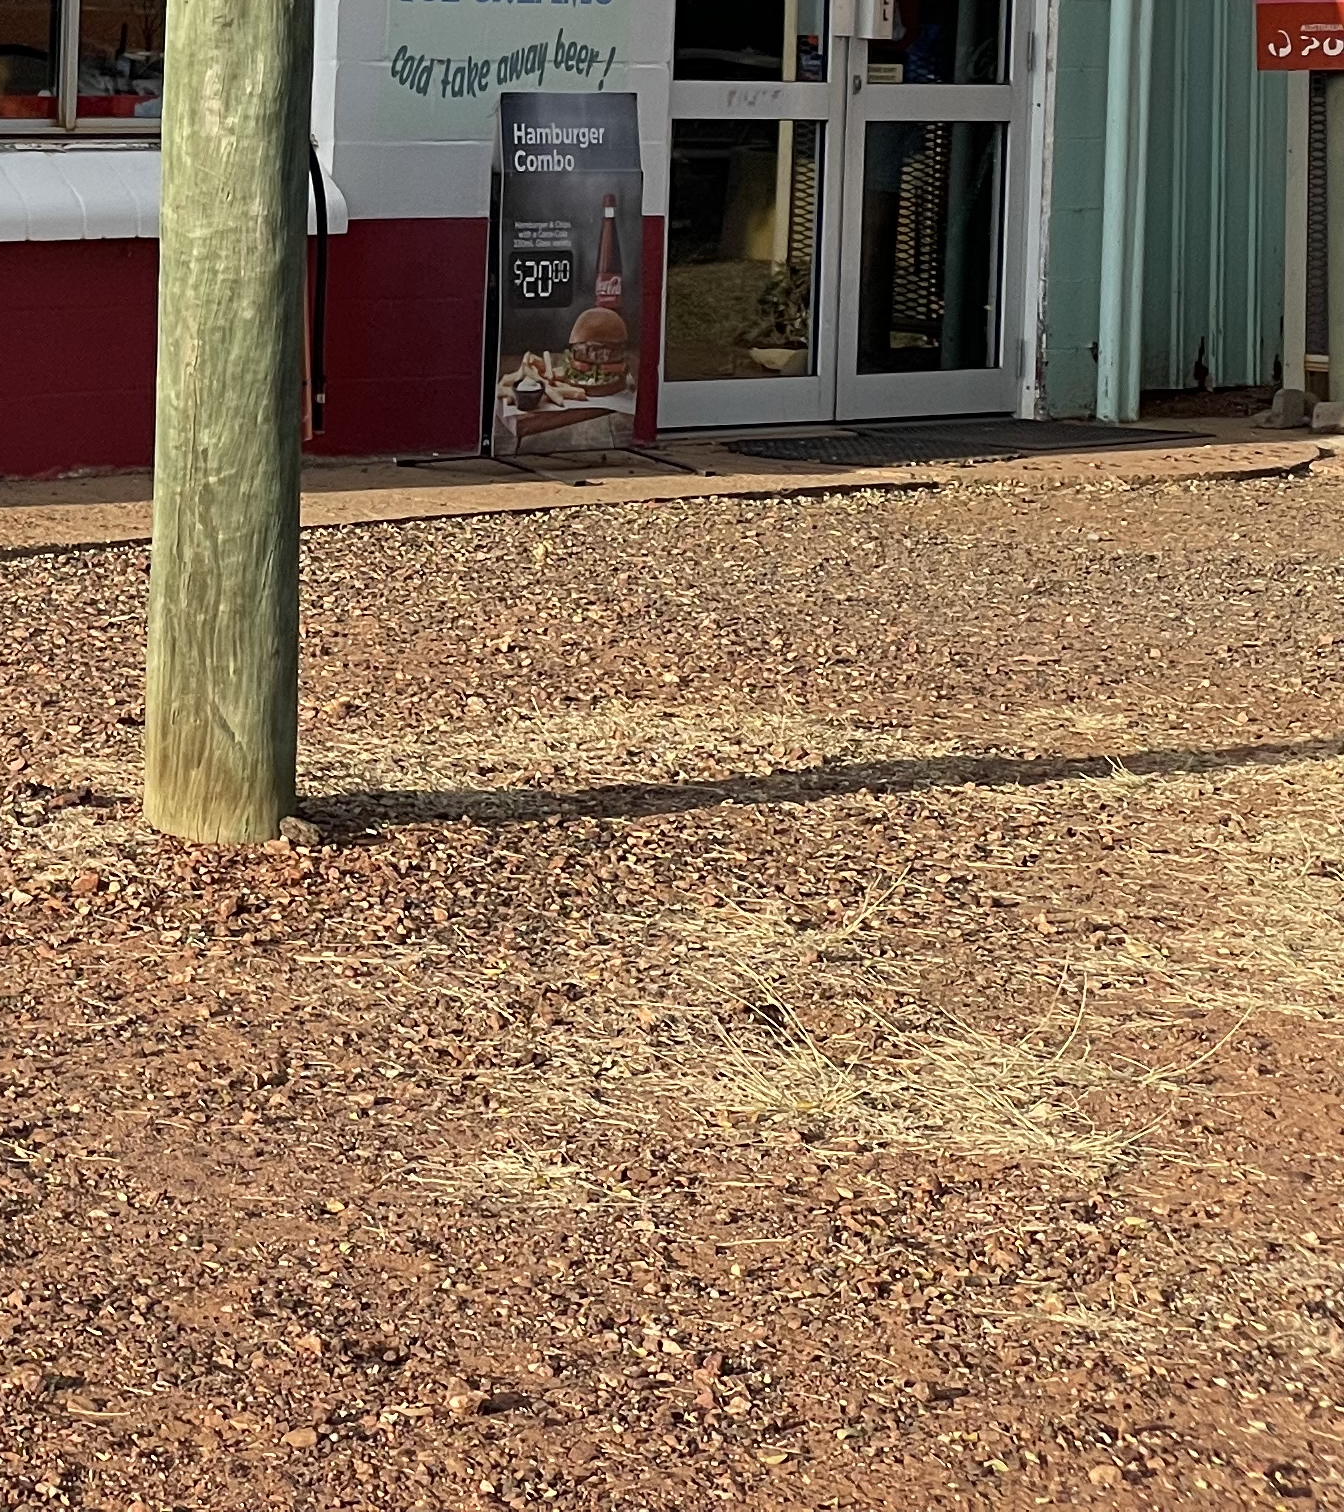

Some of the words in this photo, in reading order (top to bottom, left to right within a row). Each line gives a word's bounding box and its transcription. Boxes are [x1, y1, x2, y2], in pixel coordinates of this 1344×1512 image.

[391, 45, 435, 96] Cold
[441, 55, 491, 98] take
[497, 41, 549, 86] away
[513, 122, 605, 149] Hamburger
[514, 150, 576, 172] Combo
